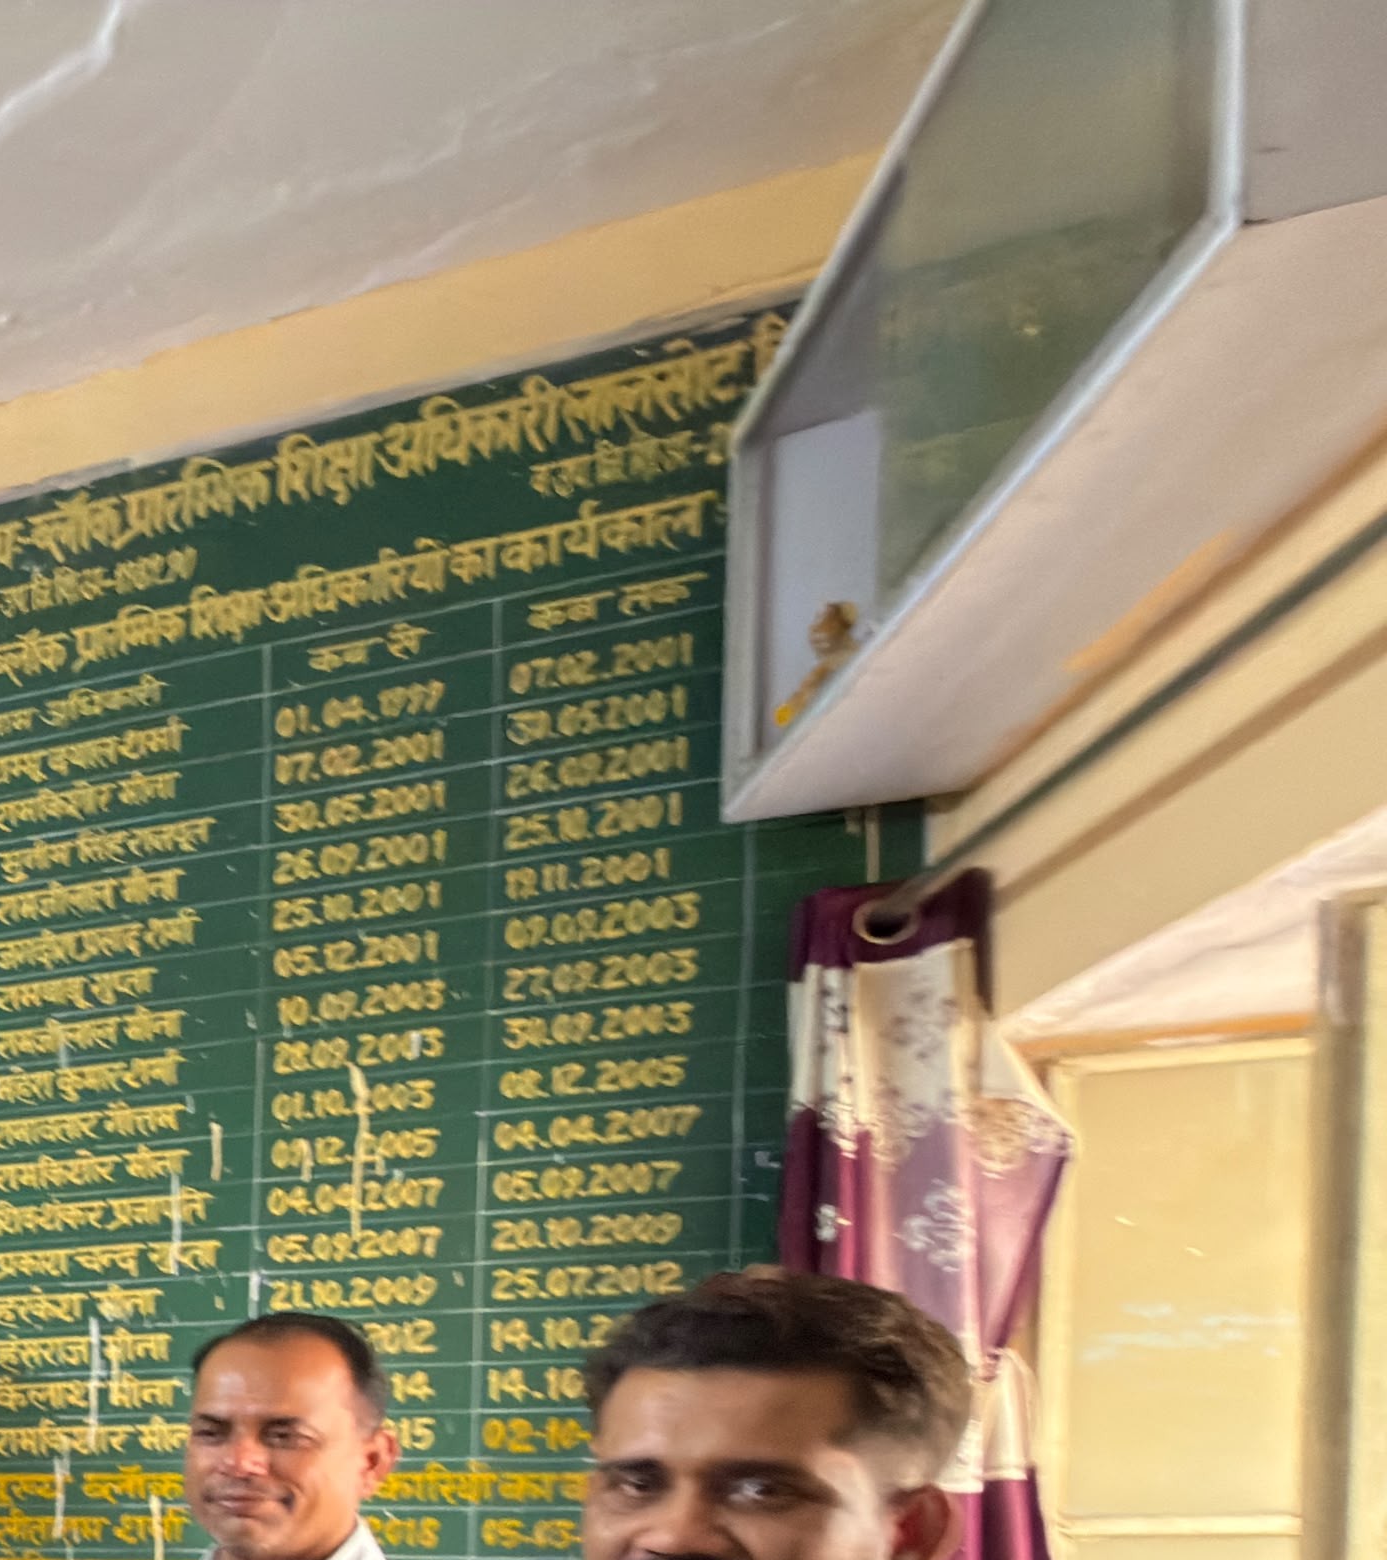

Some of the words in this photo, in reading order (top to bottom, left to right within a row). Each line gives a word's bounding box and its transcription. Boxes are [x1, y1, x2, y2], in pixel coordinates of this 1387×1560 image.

[275, 433, 381, 505] शिक्षा
[377, 375, 564, 477] अधिकारी
[489, 1313, 617, 1352] 14.10.2
